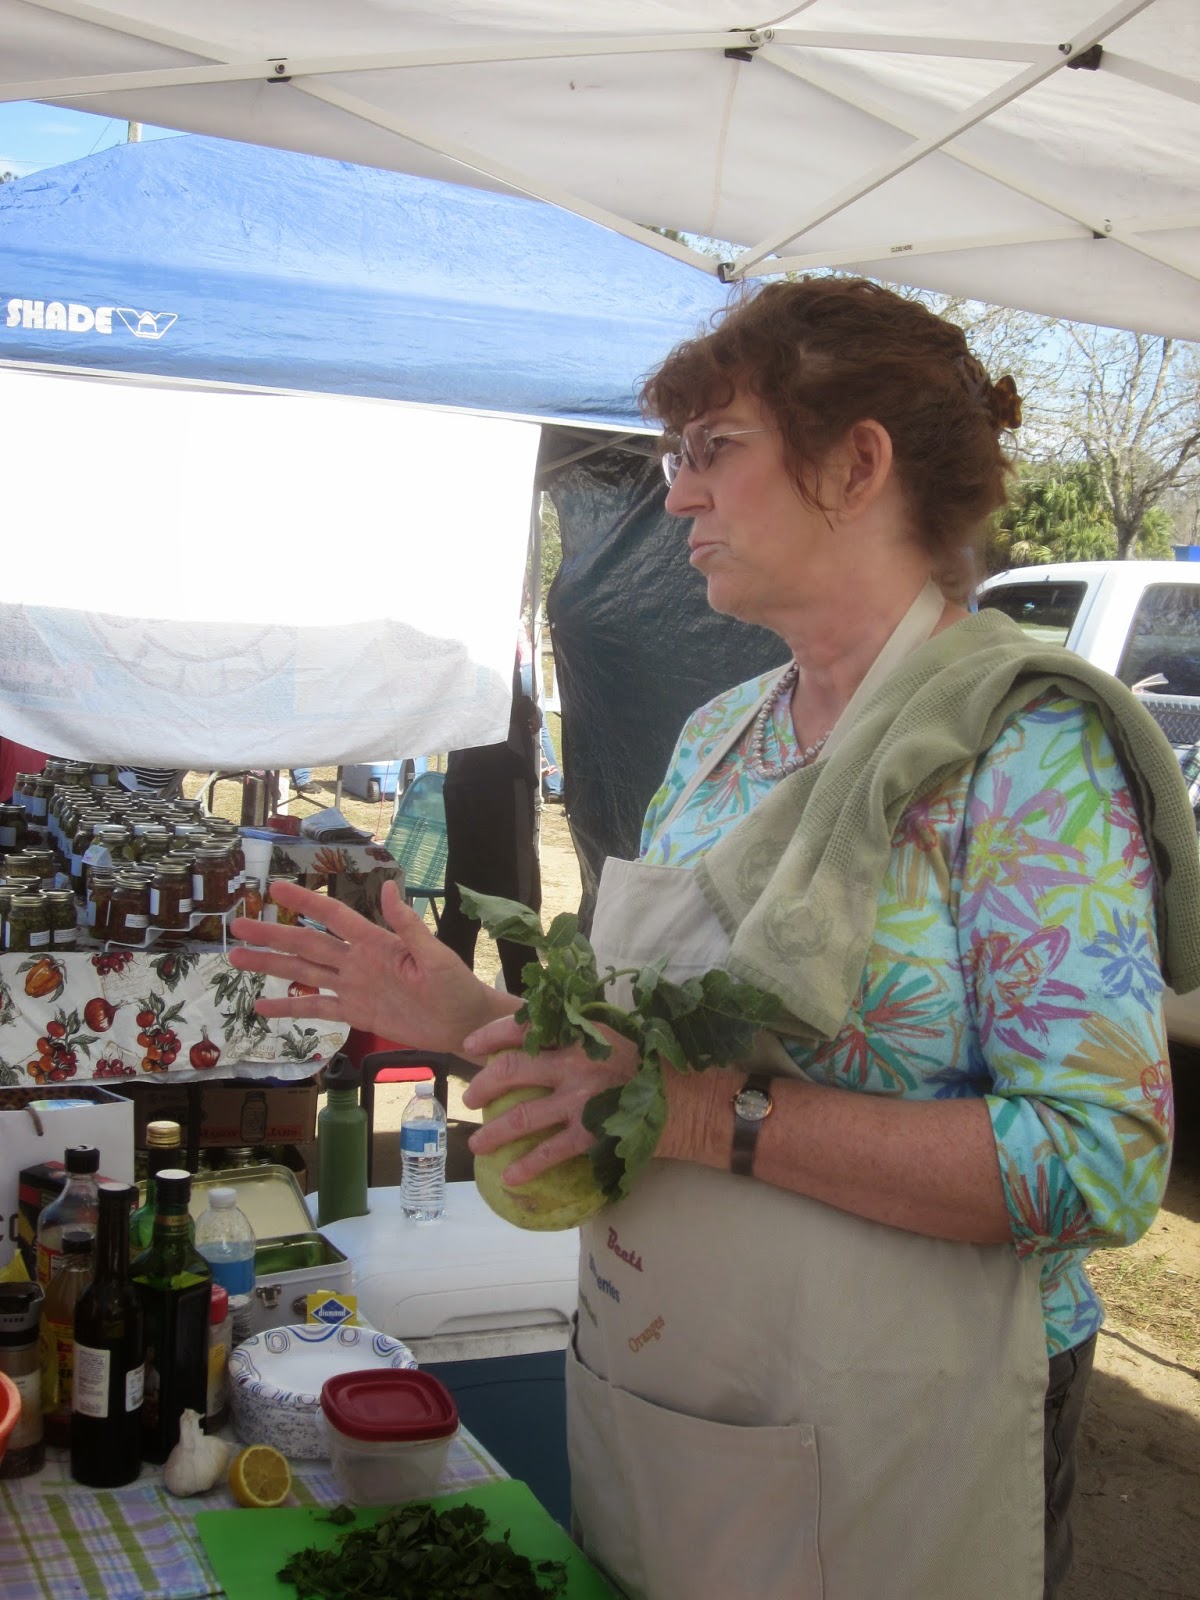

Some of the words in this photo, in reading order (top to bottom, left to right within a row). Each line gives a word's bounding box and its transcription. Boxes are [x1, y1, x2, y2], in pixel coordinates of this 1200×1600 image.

[6, 298, 114, 335] SHADE
[318, 1306, 346, 1317] diamond
[628, 1314, 666, 1353] Oranges
